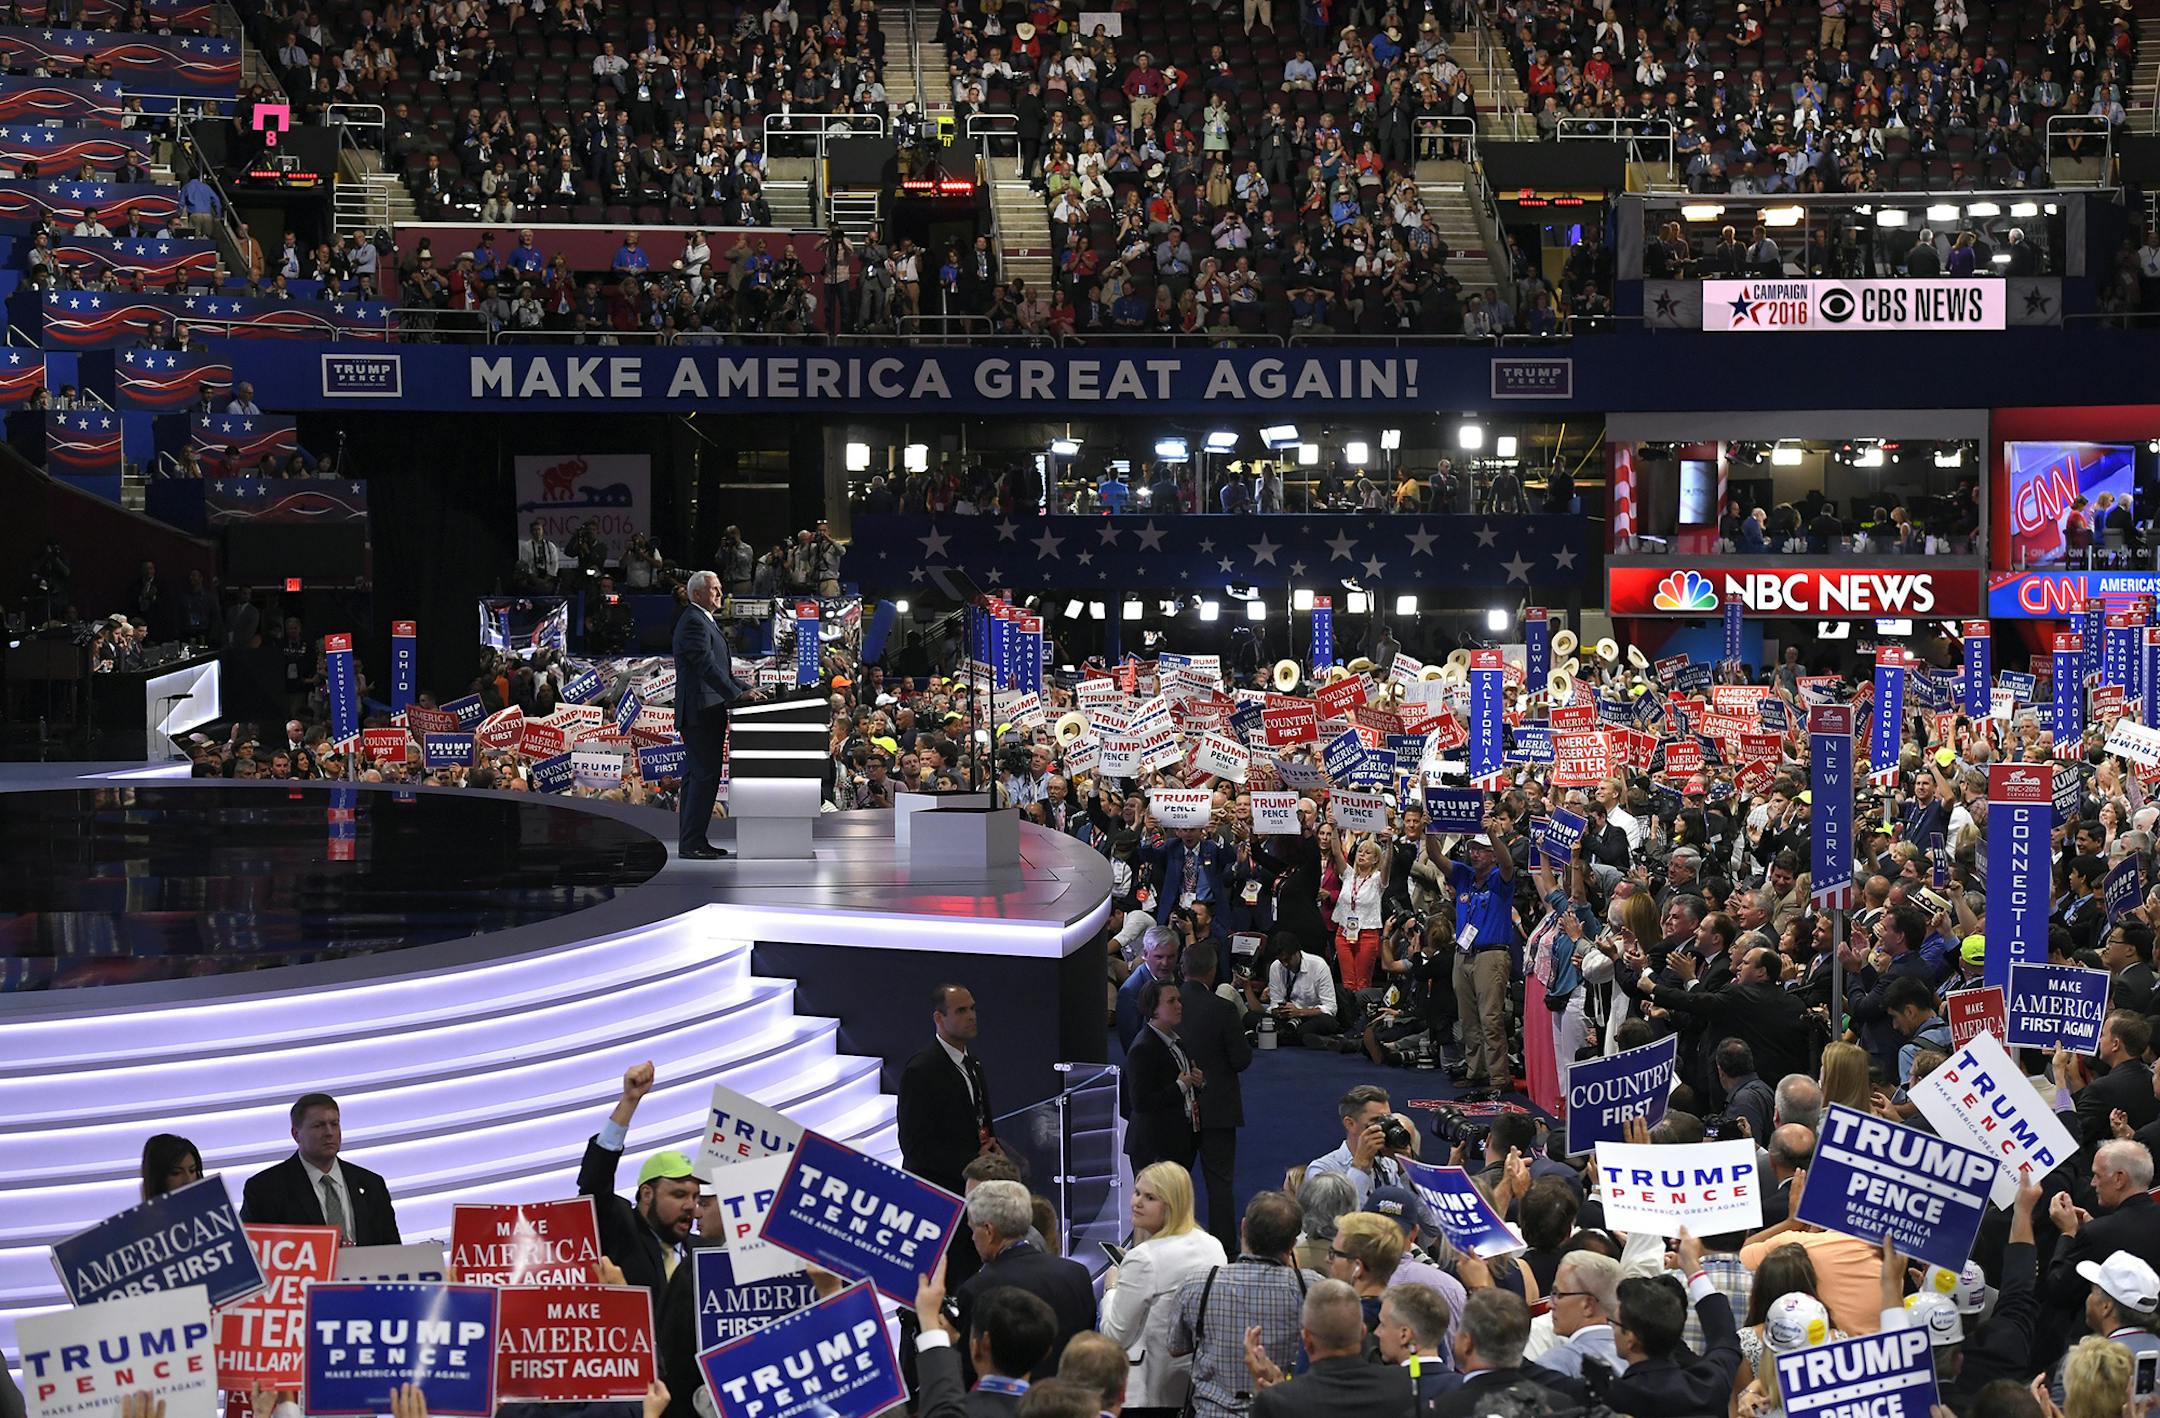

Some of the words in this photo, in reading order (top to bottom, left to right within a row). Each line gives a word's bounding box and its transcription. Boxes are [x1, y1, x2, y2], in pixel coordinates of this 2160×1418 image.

[265, 131, 278, 147] 8
[1753, 284, 1808, 299] CAMPAIGN
[1769, 302, 1808, 325] 2016
[1861, 288, 1907, 323] CBS
[1915, 287, 1984, 322] NEWS
[333, 364, 391, 374] TRUMP
[470, 357, 643, 398] MAKE
[666, 358, 952, 398] AMERICA
[973, 358, 1182, 399] GREAT
[1203, 359, 1419, 398] AGAIN!
[1503, 368, 1561, 377] TRUMP
[2015, 455, 2080, 538] CNN
[1726, 574, 1808, 612] NBC
[1819, 573, 1935, 612] NEWS
[2018, 575, 2088, 613] CNN
[2090, 613, 2099, 665] MONTANA
[1532, 632, 1542, 674] IOWA
[398, 650, 409, 691] OHIO
[1179, 670, 1214, 684] TRUMP
[1974, 641, 1983, 708] GEORGIA
[336, 654, 348, 731] PENNSYLVANIA
[1319, 682, 1362, 704] COUNTRY
[1718, 688, 1764, 696] AMERICA
[2000, 680, 2032, 691] AMERICA
[1333, 696, 1355, 709] FIRST
[1265, 714, 1315, 729] COUNTRY
[1482, 673, 1492, 765] CALIFORNIA
[1553, 718, 1593, 729] AMERICA
[1705, 716, 1749, 732] AMERICA
[1881, 671, 1895, 758] WISCONSIN
[364, 737, 405, 747] COUNTRY
[490, 731, 513, 742] FIRST
[1279, 728, 1303, 738] FIRST
[1557, 736, 1607, 748] AMERICA
[373, 747, 393, 755] FIRST
[428, 743, 472, 751] TRUMP
[1104, 753, 1129, 761] PENCE
[1205, 737, 1249, 760] TRUMP
[1211, 750, 1240, 767] PENCE
[1326, 740, 1362, 768] AMERICA
[1558, 748, 1607, 759] DESERVES
[2110, 738, 2159, 758] TRUMP
[573, 762, 621, 772] TRUMP
[654, 763, 678, 773] FIRST
[1560, 758, 1607, 772] BETTER
[1824, 741, 1838, 785] NEW
[1154, 794, 1209, 803] TRUMP
[1253, 798, 1297, 808] TRUMP
[1332, 795, 1383, 809] TRUMP
[1428, 800, 1481, 811] TRUMP
[2055, 789, 2078, 811] PENCE
[1262, 810, 1289, 818] PENCE
[1343, 808, 1374, 818] PENCE
[1550, 818, 1579, 839] TRUMP
[1825, 805, 1837, 867] YORK
[2010, 809, 2029, 958] CONNECTIC
[2048, 978, 2082, 994] MAKE
[1964, 1002, 1985, 1016] MAKE
[2011, 994, 2104, 1021] AMERICA
[2020, 1017, 2062, 1034] FIRST
[2062, 1020, 2095, 1038] AGAIN
[1570, 1059, 1673, 1109] COUNTRY
[1602, 1098, 1653, 1127] FIRST
[1934, 1082, 1951, 1102] MAKE
[1951, 1103, 1980, 1136] AMERICA
[1978, 1135, 1999, 1158] GREAT
[1957, 1050, 2055, 1168] TRUMP
[1944, 1070, 2034, 1175] PENCE
[1828, 1110, 1995, 1188] TRUMP
[1603, 1164, 1753, 1188] TRUMP
[799, 1163, 942, 1243] TRUMP
[1415, 1183, 1478, 1212] TRUMP
[1612, 1186, 1747, 1204] PENCE
[1846, 1172, 1946, 1225] PENCE
[1613, 1203, 1639, 1212] MAKE
[1641, 1206, 1681, 1216] AMERICA
[1684, 1205, 1714, 1216] GREAT
[1717, 1201, 1750, 1211] AGAIN!
[1846, 1202, 1876, 1223] MAKE
[1878, 1211, 1932, 1238] AMERICA
[496, 1219, 548, 1237] MAKE
[798, 1194, 918, 1258] PENCE
[1846, 1214, 1883, 1236] GREAT
[1885, 1223, 1926, 1249] AGAIN!
[75, 1204, 237, 1298] AMERICAN
[790, 1208, 815, 1228] MAKE
[814, 1218, 854, 1243] AMERICA
[854, 1238, 883, 1257] GREAT
[883, 1250, 915, 1272] AGAIN!
[452, 1236, 599, 1269] AMERICA
[166, 1240, 234, 1289] FIRST
[464, 1271, 515, 1285] FIRST
[523, 1267, 586, 1285] AGAIN
[548, 1303, 600, 1320] MAKE
[316, 1320, 486, 1346] TRUMP
[500, 1326, 650, 1354] AMERICA
[25, 1322, 209, 1378] TRUMP
[218, 1350, 303, 1373] HILLARY
[330, 1348, 468, 1366] PENCE
[721, 1318, 878, 1405] TRUMP
[1779, 1330, 1928, 1393] TRUMP
[38, 1354, 204, 1402] PENCE
[324, 1370, 351, 1380] MAKE
[354, 1370, 397, 1380] AMERICA
[434, 1370, 470, 1380] AGAIN!
[510, 1358, 563, 1379] FIRST
[572, 1358, 639, 1378] AGAIN
[745, 1350, 874, 1418] PENCE
[820, 1381, 852, 1405] GREAT
[850, 1368, 882, 1391] AGAIN!
[41, 1404, 73, 1418] MAKE
[168, 1380, 207, 1397] AGAIN!
